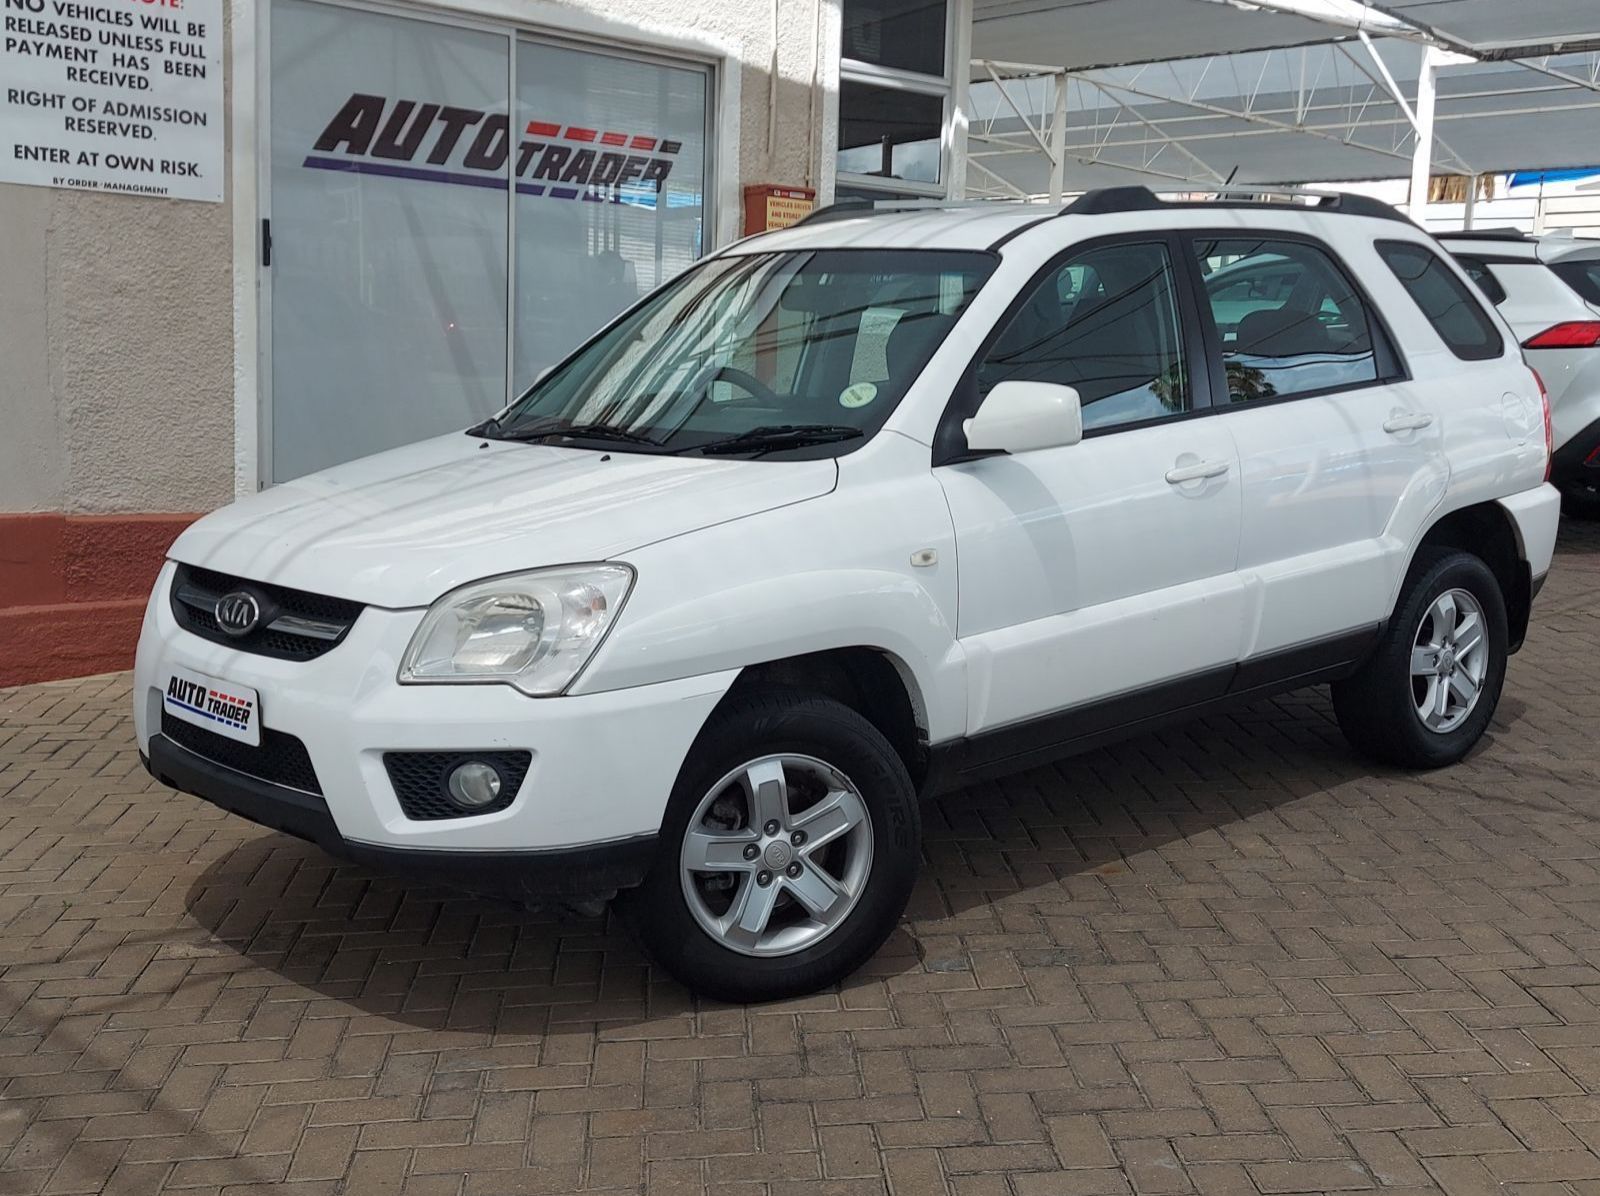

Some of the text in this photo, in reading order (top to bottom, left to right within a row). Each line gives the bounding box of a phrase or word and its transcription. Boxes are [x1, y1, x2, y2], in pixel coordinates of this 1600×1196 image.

[5, 0, 45, 13] NO
[53, 1, 133, 27] VEHICLES
[140, 14, 181, 34] WILL
[187, 22, 206, 38] BE
[5, 16, 206, 59] RELEASED UNLESS FULL
[5, 37, 206, 78] PAYMENT HAS BEEN
[67, 66, 153, 91] RECEIVED.
[8, 88, 207, 126] RIGHT OF ADMISSION
[64, 116, 157, 141] RESERVED.
[312, 93, 673, 194] AUTO TRADER
[14, 144, 203, 178] ENTER AT OWN RISK.
[53, 177, 169, 195] BY ORDER MANAGEMENT
[221, 599, 250, 626] KIA
[168, 676, 251, 724] AUTO TRADER
